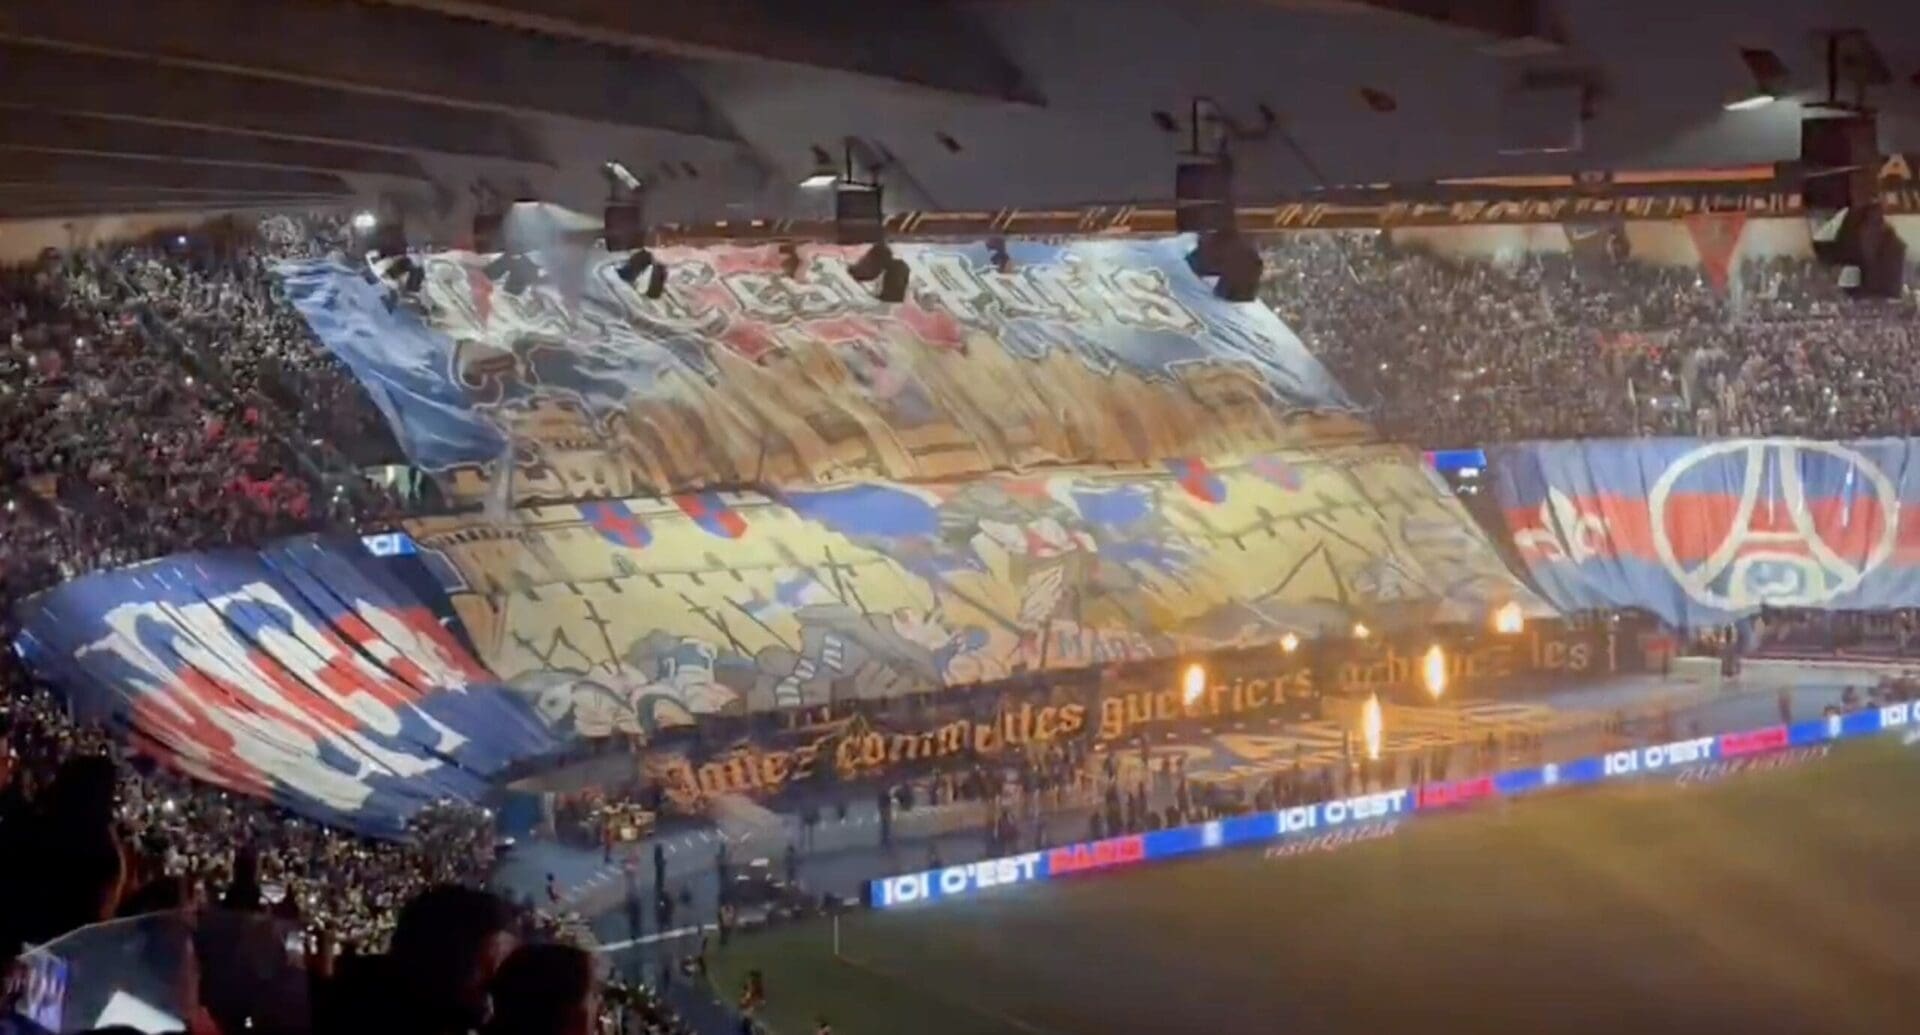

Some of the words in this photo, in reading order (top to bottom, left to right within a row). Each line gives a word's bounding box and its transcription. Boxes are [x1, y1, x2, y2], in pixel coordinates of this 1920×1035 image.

[1604, 752, 1638, 776] ICI
[1278, 804, 1317, 834] ICI
[1324, 789, 1407, 824] C'EST
[882, 872, 930, 906] ICI
[939, 851, 1042, 894] C'EST
